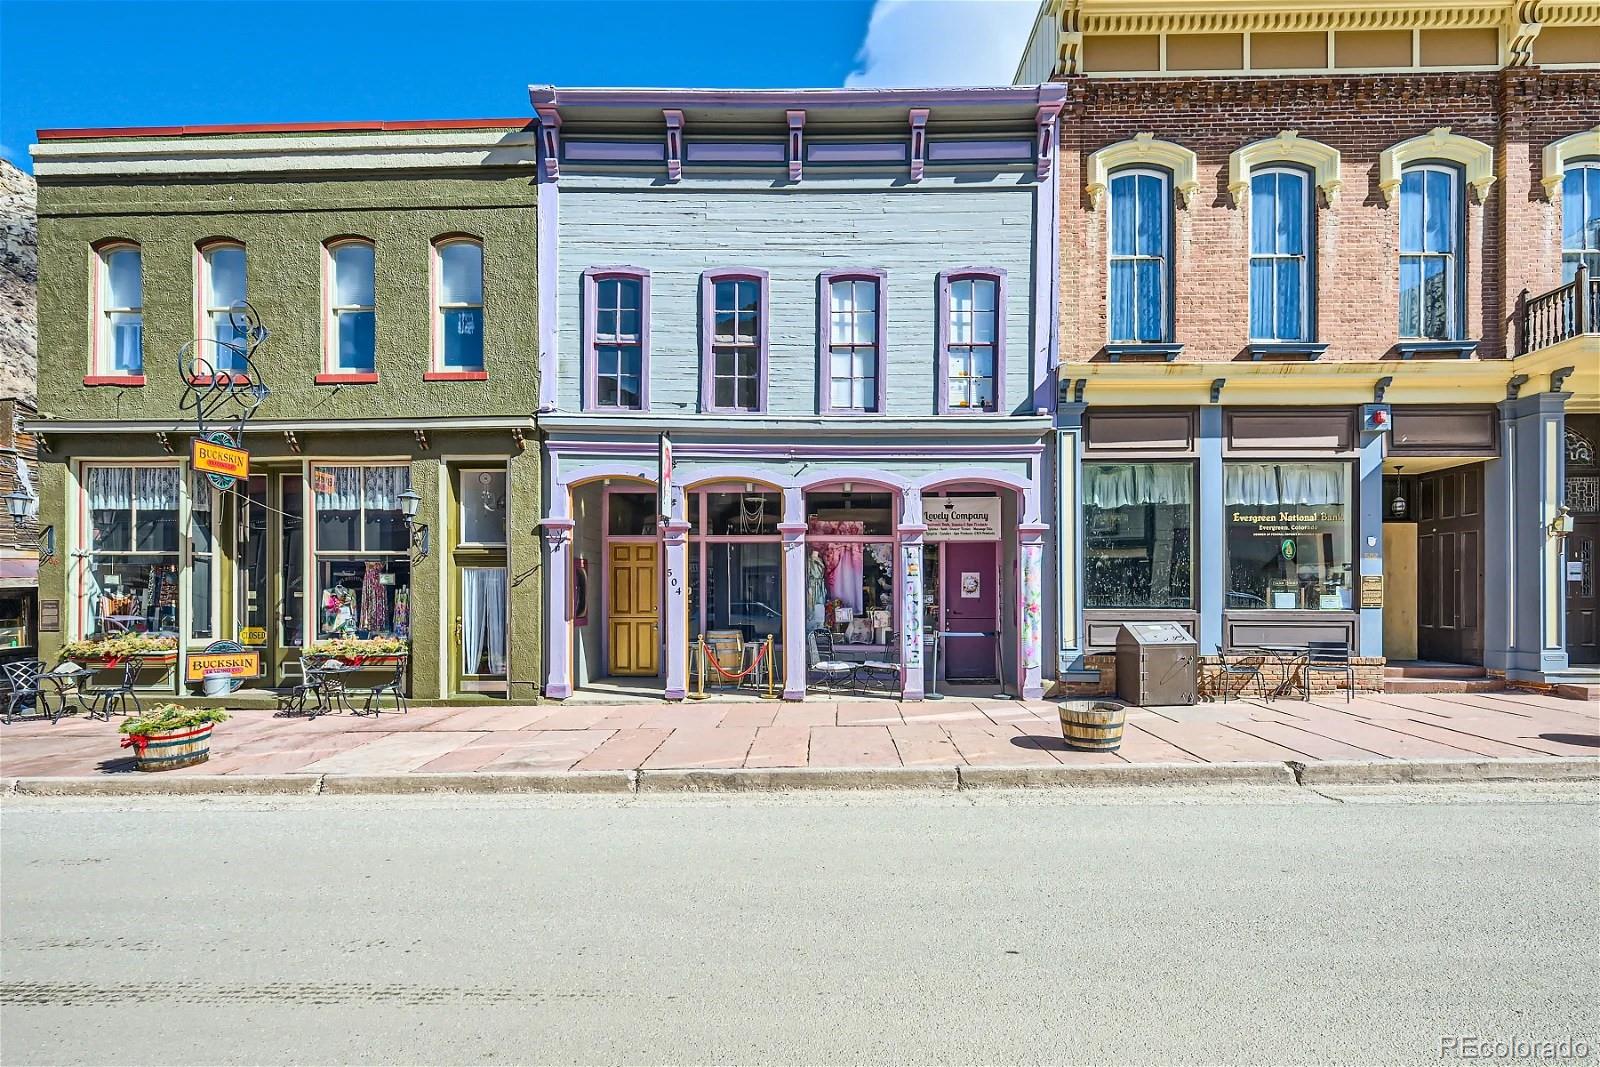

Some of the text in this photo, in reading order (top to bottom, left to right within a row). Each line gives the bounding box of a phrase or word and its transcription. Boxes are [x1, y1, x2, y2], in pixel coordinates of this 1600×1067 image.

[199, 447, 244, 467] BUCKSKIN
[923, 511, 989, 522] Lovely Company
[1233, 512, 1276, 523] Evergreen
[1279, 512, 1317, 522] National
[667, 568, 681, 595] 504
[241, 631, 266, 639] CLOSED
[193, 659, 253, 671] BUCKSKIN
